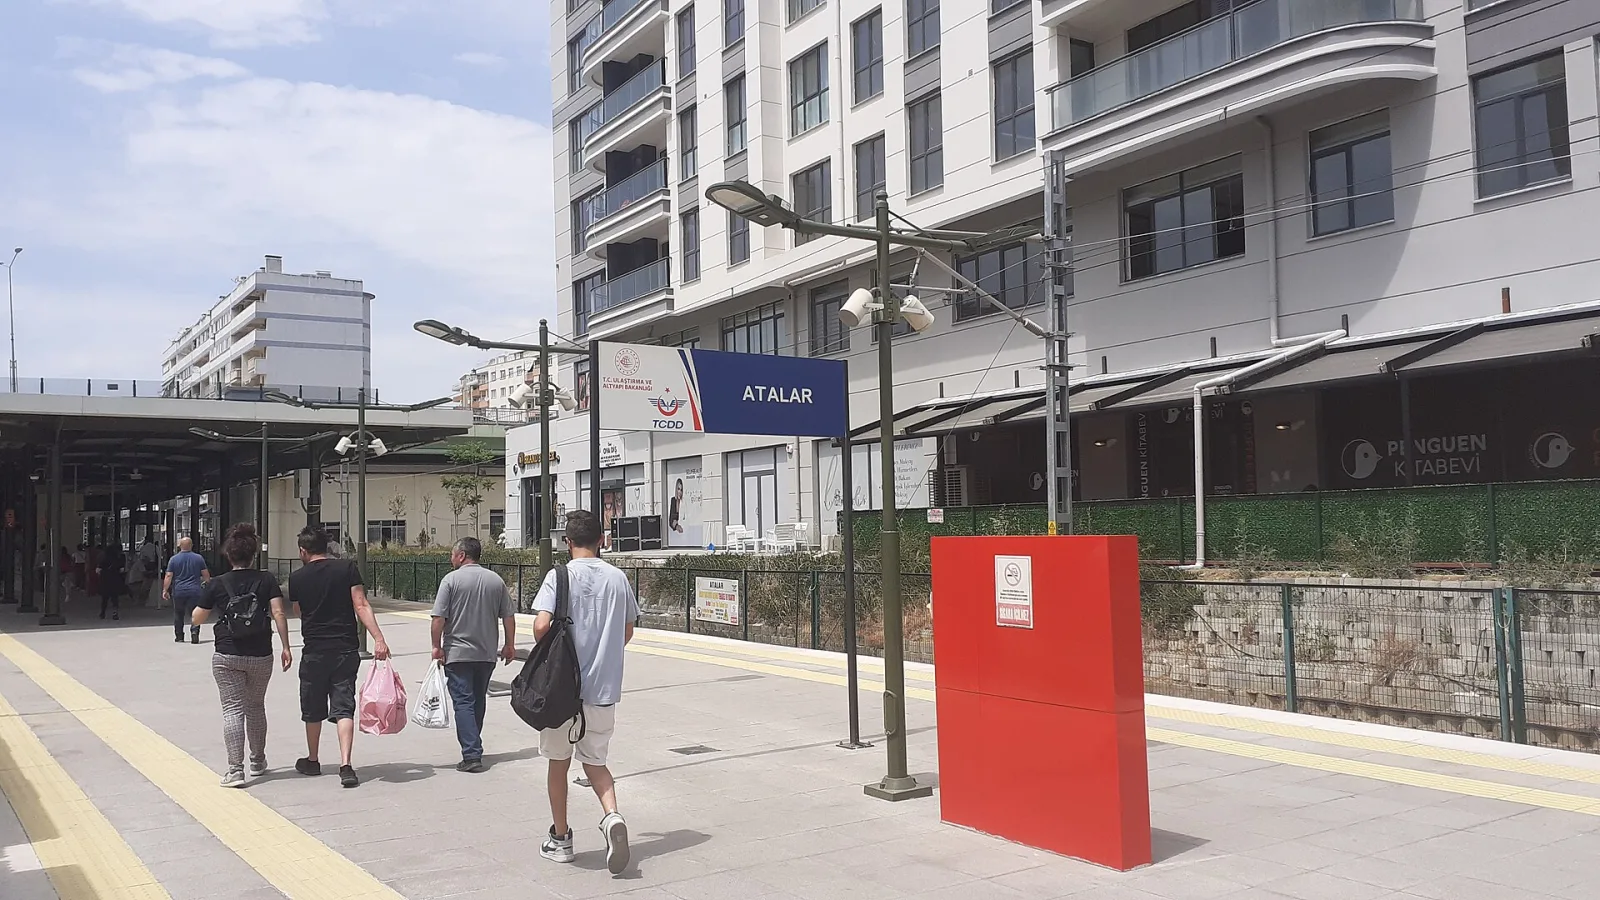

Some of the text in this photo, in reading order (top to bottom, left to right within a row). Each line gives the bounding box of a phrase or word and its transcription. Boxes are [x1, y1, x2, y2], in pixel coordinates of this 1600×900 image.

[742, 385, 813, 404] ATALAR
[652, 420, 684, 429] TCDD
[1138, 412, 1147, 458] KİTABEV
[1394, 453, 1480, 477] KTABEVİ
